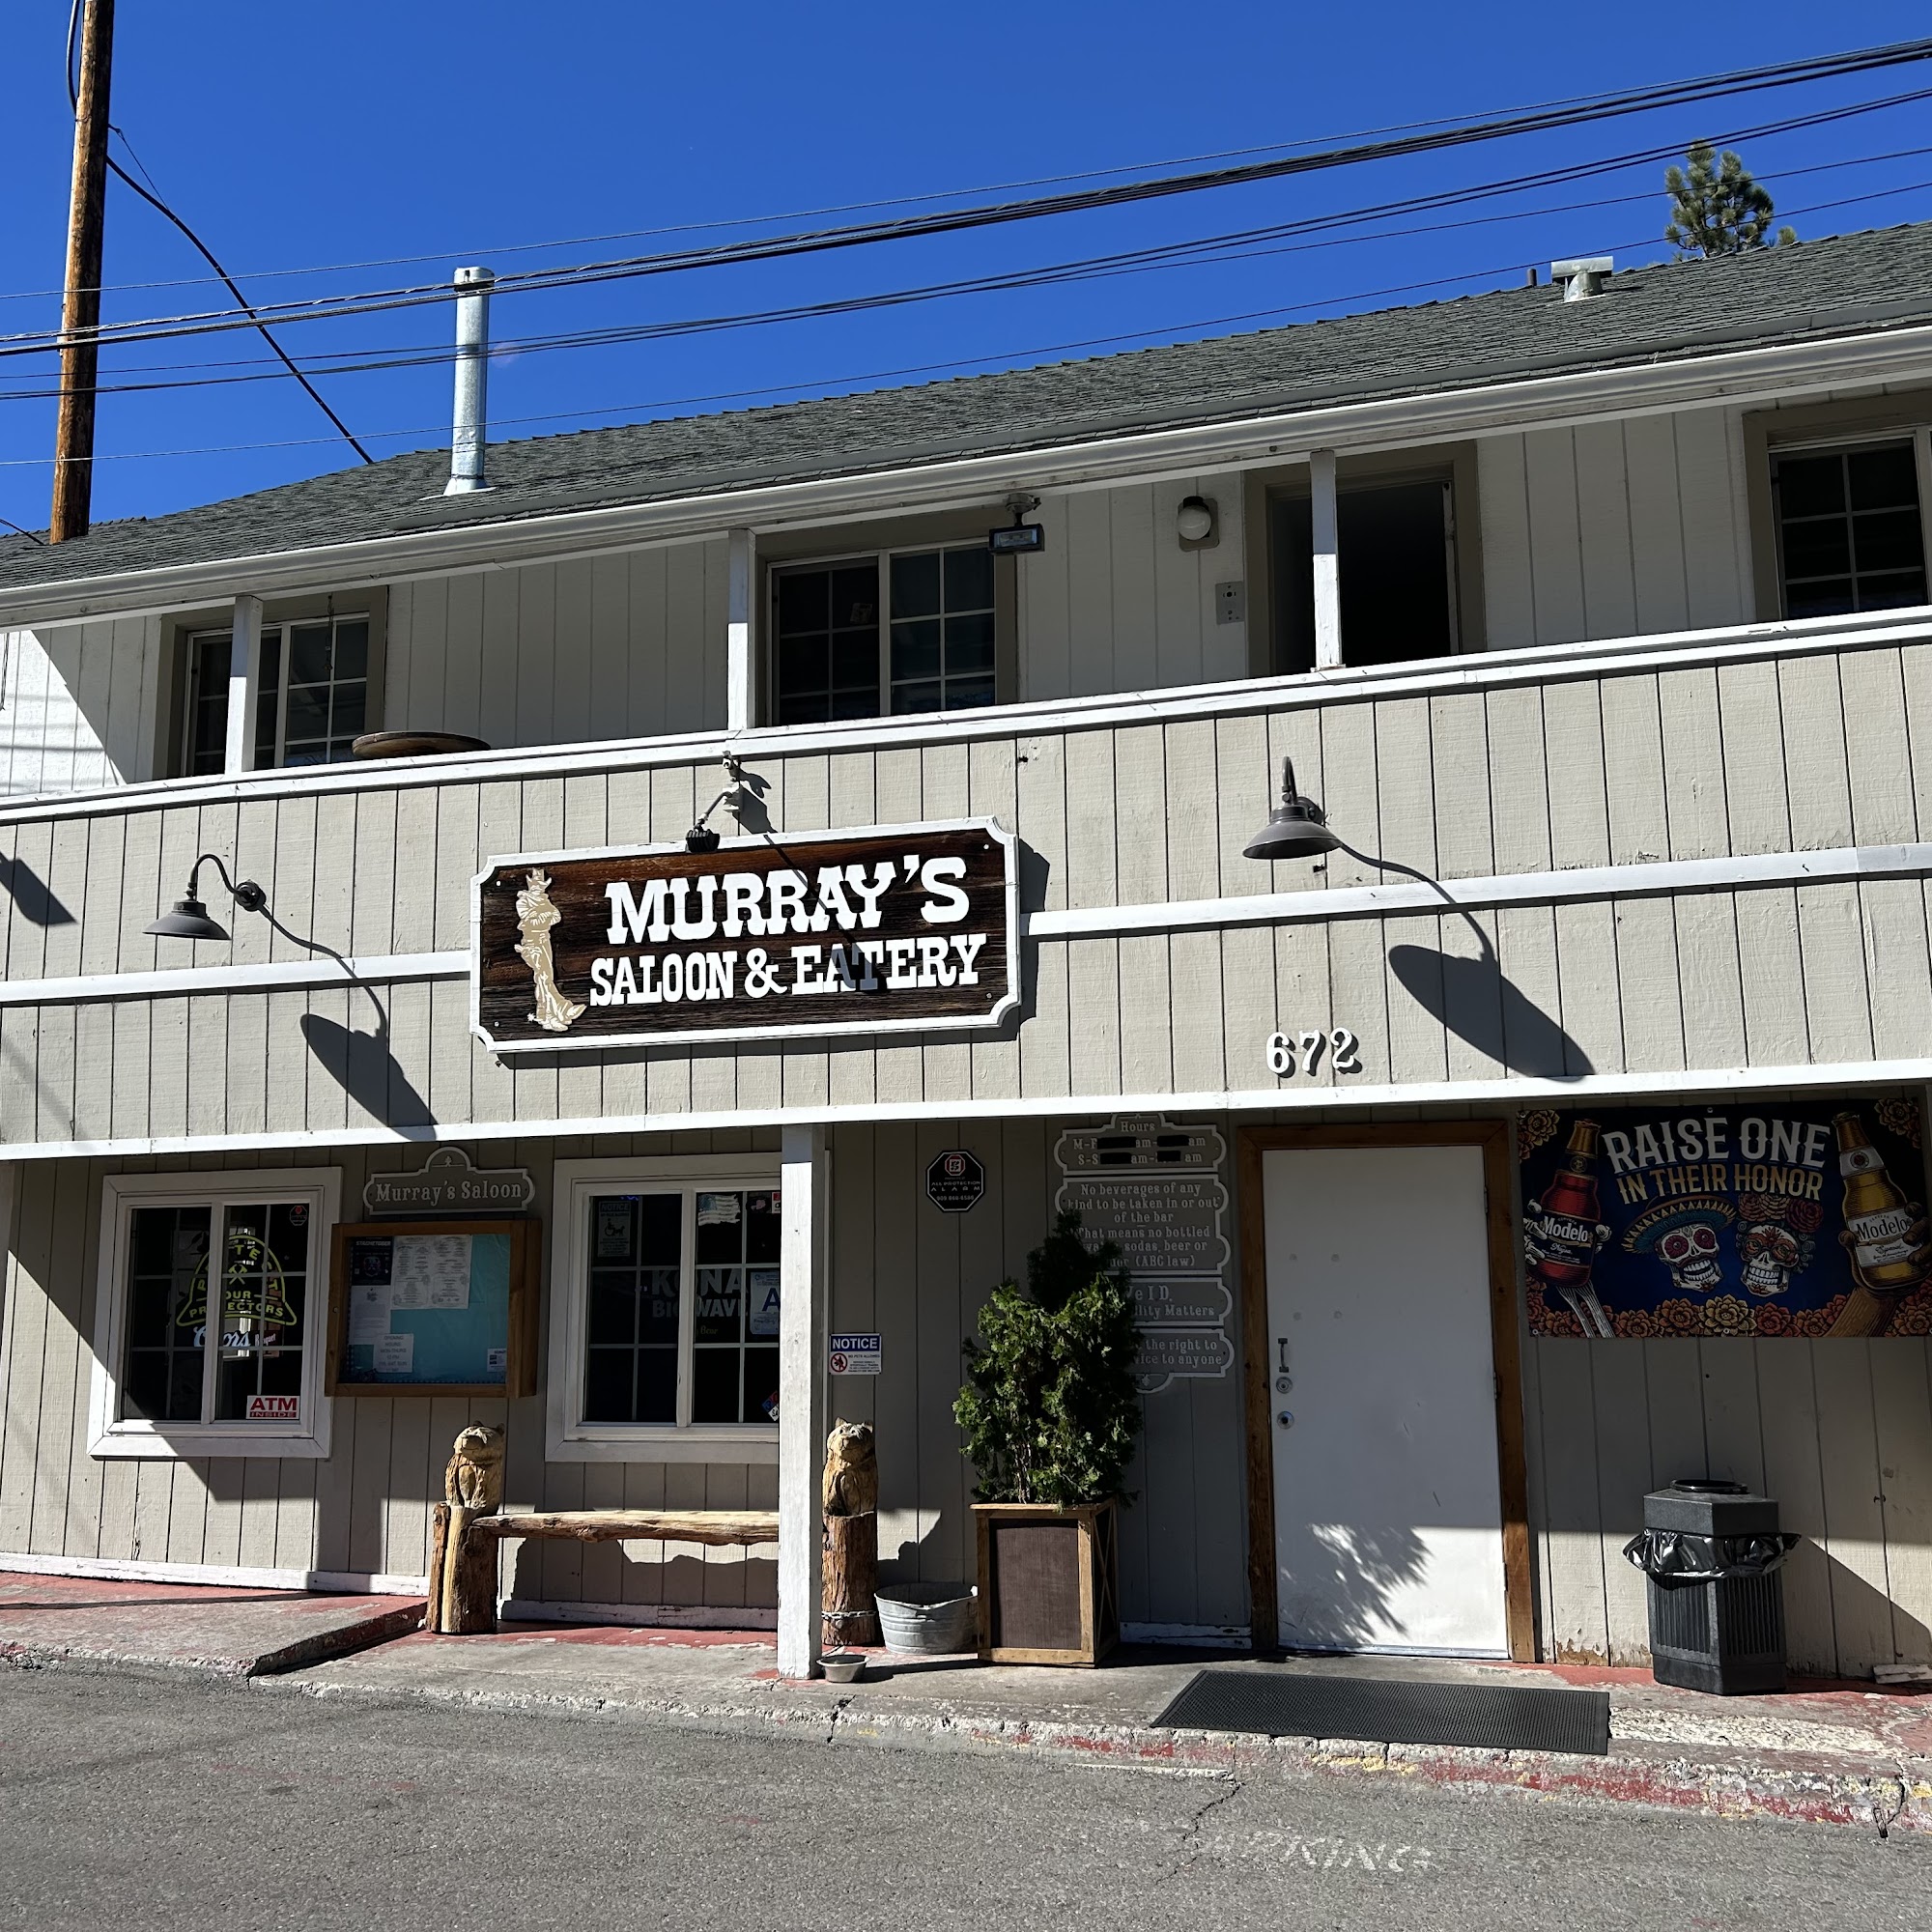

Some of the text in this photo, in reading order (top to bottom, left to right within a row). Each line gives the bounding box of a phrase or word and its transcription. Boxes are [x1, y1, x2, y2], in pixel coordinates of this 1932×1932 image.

[603, 854, 971, 945] MURRAY'S
[589, 933, 987, 1007] SALOON & EATERY
[1265, 1027, 1354, 1073] 672
[1121, 1122, 1155, 1132] Hours
[1073, 1138, 1098, 1150] M-F
[1602, 1117, 1832, 1173] RAISE ONE
[1078, 1153, 1098, 1165] S-S
[1185, 1153, 1202, 1162] am
[1081, 1183, 1202, 1198] No beverages of any
[1616, 1163, 1824, 1205] IN THEIR HONOR
[375, 1180, 522, 1207] Murray's Saloon
[1096, 1200, 1108, 1209] to
[1112, 1199, 1125, 1209] be
[1129, 1198, 1163, 1208] taken
[1167, 1198, 1178, 1208] in
[1181, 1199, 1195, 1208] or
[1198, 1197, 1219, 1208] out
[1114, 1211, 1174, 1223] of the bar
[1108, 1229, 1145, 1238] means
[1148, 1229, 1162, 1238] no
[1166, 1227, 1209, 1237] bottled
[1543, 1215, 1588, 1242] Modelo
[1857, 1216, 1908, 1240] Modelo
[1125, 1241, 1208, 1253] sodas, beer or
[1136, 1256, 1164, 1267] (ABC
[1168, 1256, 1195, 1267] law)
[1164, 1304, 1214, 1317] Matters
[832, 1337, 878, 1350] NOTICE
[1146, 1339, 1217, 1353] the right to
[1162, 1353, 1175, 1364] to
[1178, 1354, 1222, 1369] anyone
[250, 1397, 298, 1410] ATM
